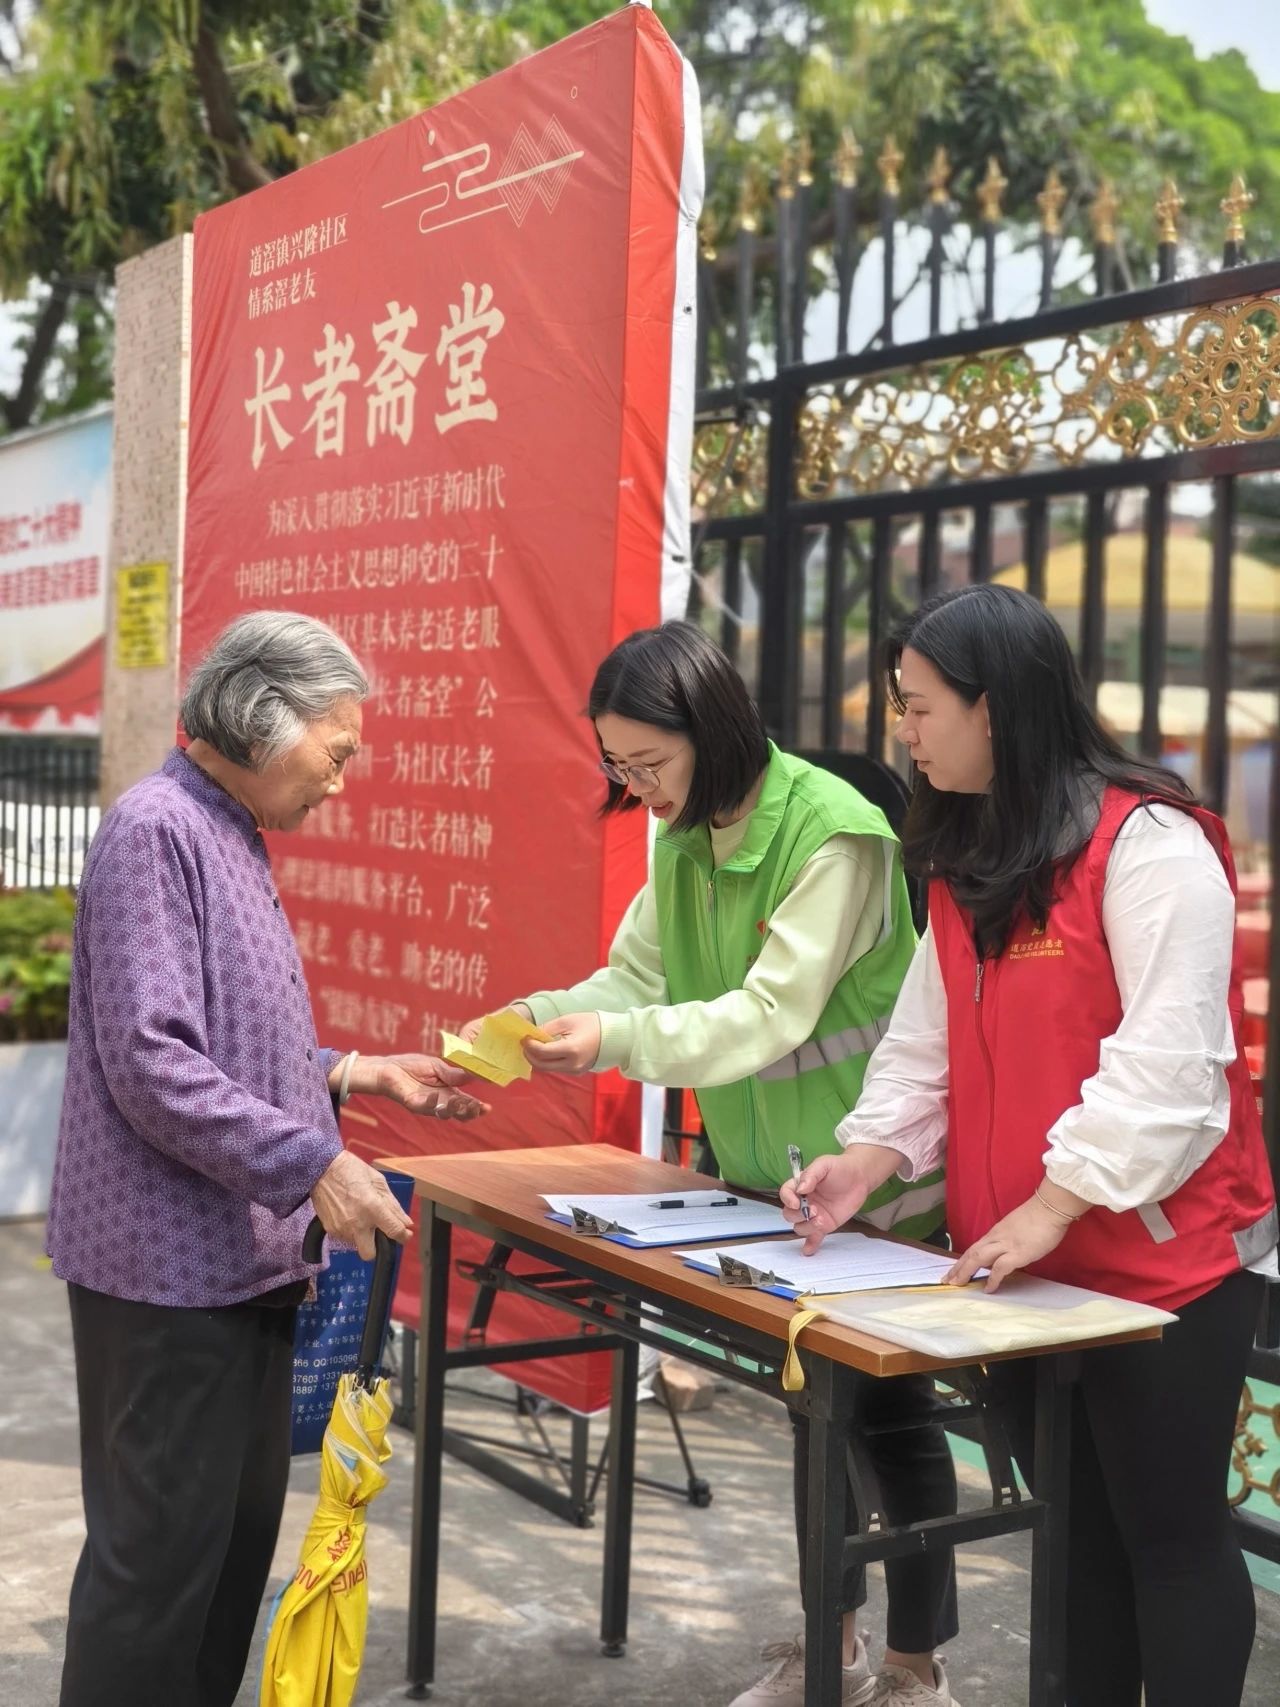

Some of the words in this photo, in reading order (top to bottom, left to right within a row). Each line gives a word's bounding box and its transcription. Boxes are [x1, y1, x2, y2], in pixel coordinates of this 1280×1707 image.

[249, 213, 348, 278] 道滘镇兴隆社区
[248, 268, 317, 320] 情系滘老友
[244, 282, 505, 471] 长者斋堂
[266, 464, 505, 537] 为深入贯彻落实习近平新时代
[235, 534, 503, 599] 中国特色社会主义思想和党的二十
